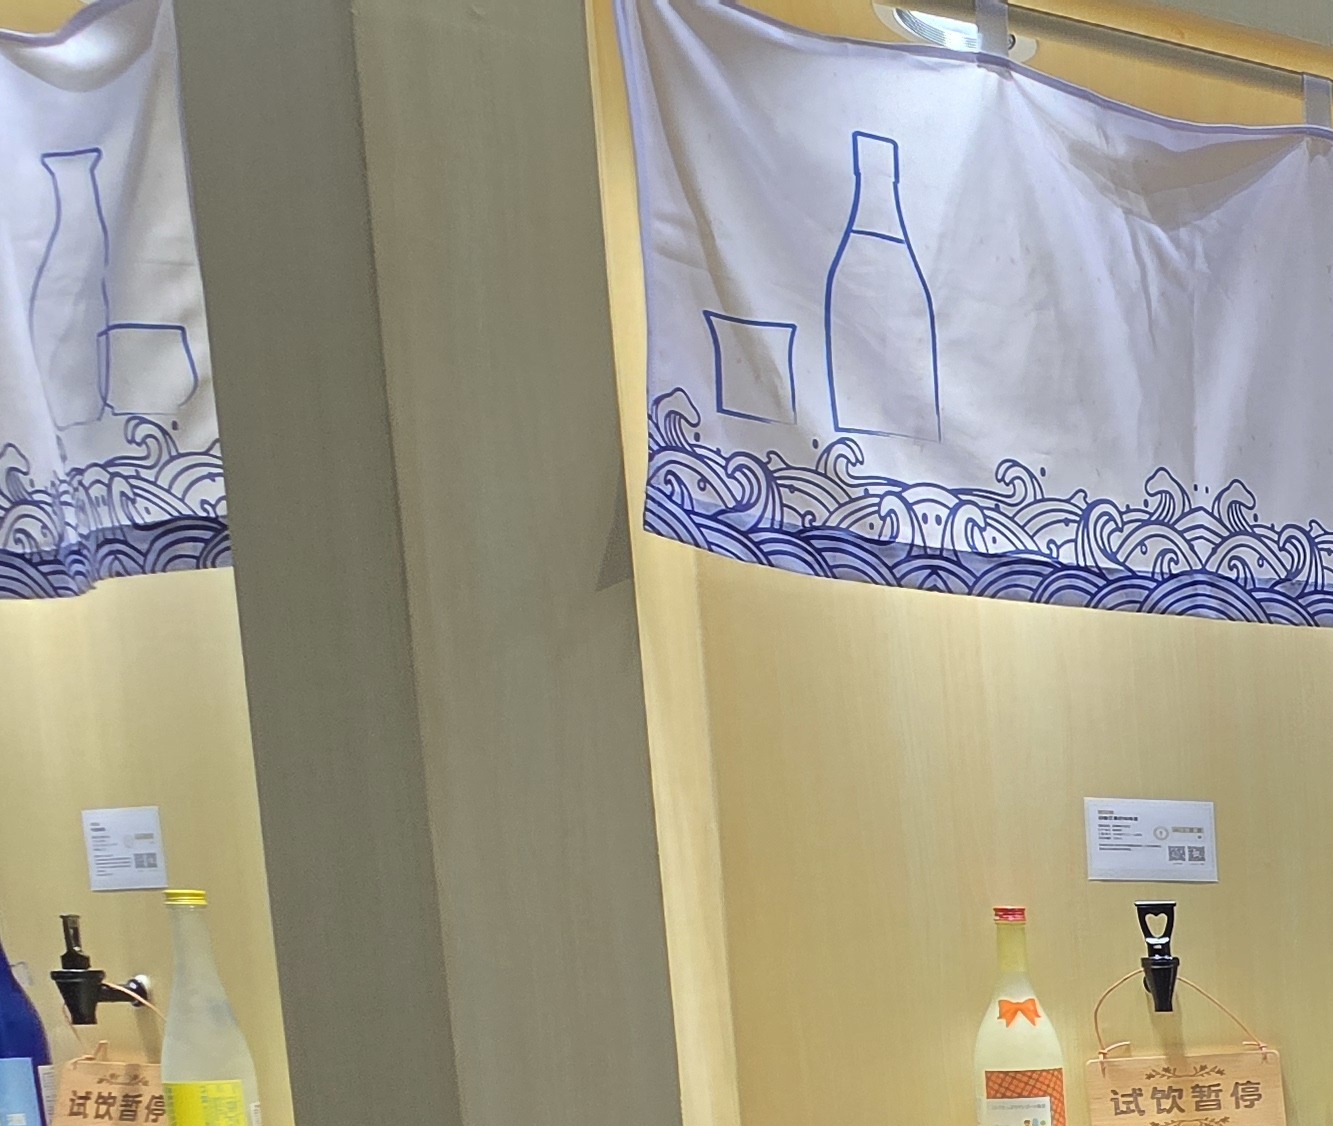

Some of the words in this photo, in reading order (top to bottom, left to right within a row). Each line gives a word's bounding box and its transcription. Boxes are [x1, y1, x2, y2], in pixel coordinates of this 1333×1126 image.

[67, 1089, 167, 1124] 试饮暂停
[1110, 1080, 1263, 1117] 试饮暂停
